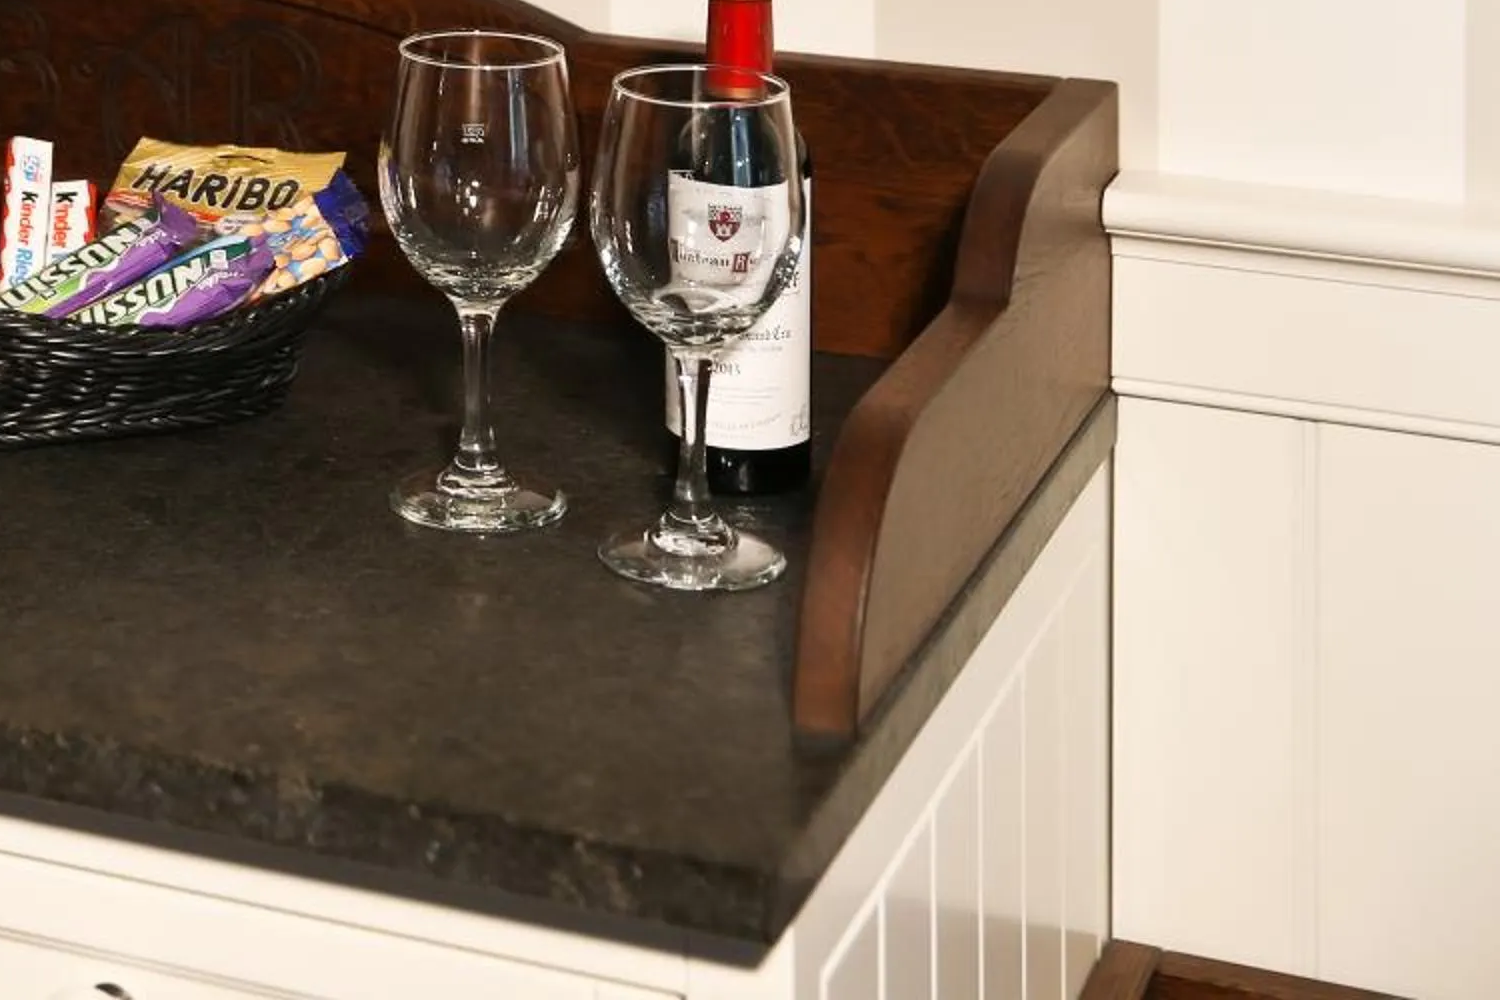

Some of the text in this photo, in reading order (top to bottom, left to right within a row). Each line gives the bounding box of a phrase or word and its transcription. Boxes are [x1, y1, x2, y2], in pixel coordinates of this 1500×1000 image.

[132, 163, 300, 211] HARIBO
[17, 190, 39, 246] Kinder
[52, 190, 78, 249] Kinder
[9, 247, 34, 287] Rieg
